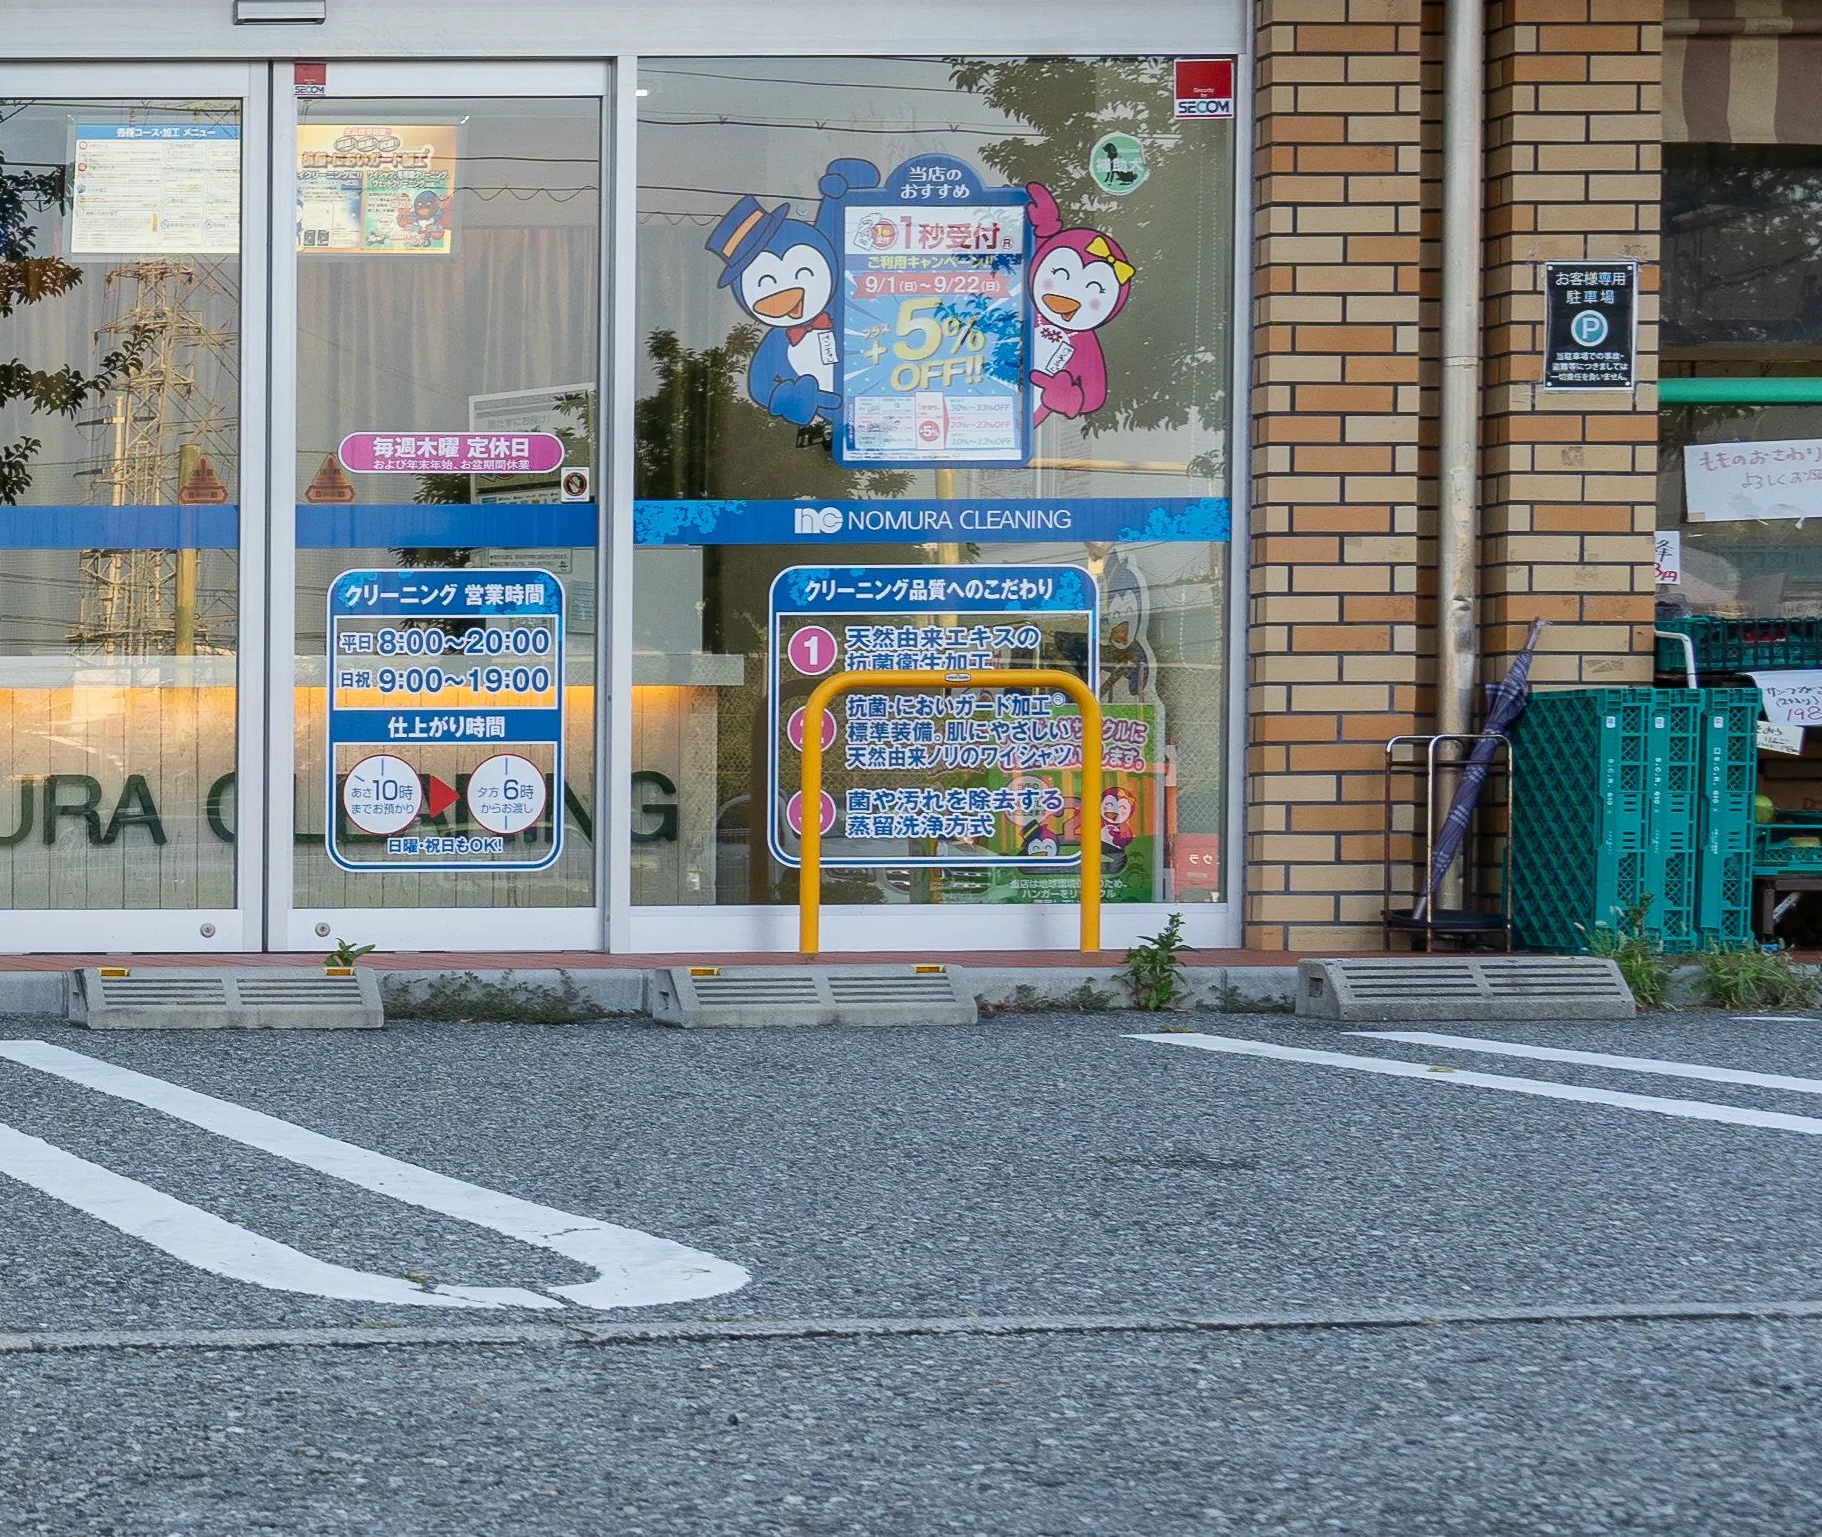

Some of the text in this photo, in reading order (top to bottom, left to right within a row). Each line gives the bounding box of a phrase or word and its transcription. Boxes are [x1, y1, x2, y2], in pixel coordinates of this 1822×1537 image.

[1179, 100, 1229, 113] SECOM
[183, 128, 216, 138] メニュー
[909, 166, 962, 182] 当店の
[900, 184, 970, 199] おすすめ
[900, 215, 1000, 250] 1秒受付
[1555, 272, 1626, 286] お客様専用
[1566, 290, 1615, 304] 駐車場
[862, 324, 890, 339] プラス
[373, 437, 529, 458] 毎週木曜 定休日
[848, 510, 953, 530] NOMURA
[959, 509, 1071, 530] CLEANING
[345, 584, 544, 605] クリーニング 営業時間
[804, 579, 1054, 602] クリーニング品質へのこだわり
[340, 633, 372, 653] 平日
[845, 625, 1041, 651] 天然由来エキスの
[803, 634, 821, 667] 1
[341, 672, 371, 689] 日祝
[388, 716, 505, 738] 仕上がり時間
[847, 720, 1072, 744] 標準装備。肌にやさしい
[846, 745, 1075, 770] 天然由来ノリのワイシャツ
[351, 803, 414, 814] までお預かり
[480, 803, 534, 814] からお渡し
[847, 788, 1063, 813] 菌や汚れを除去する
[847, 813, 996, 839] 蒸留洗浄方式
[387, 837, 503, 854] 日曜・祝日もOK!
